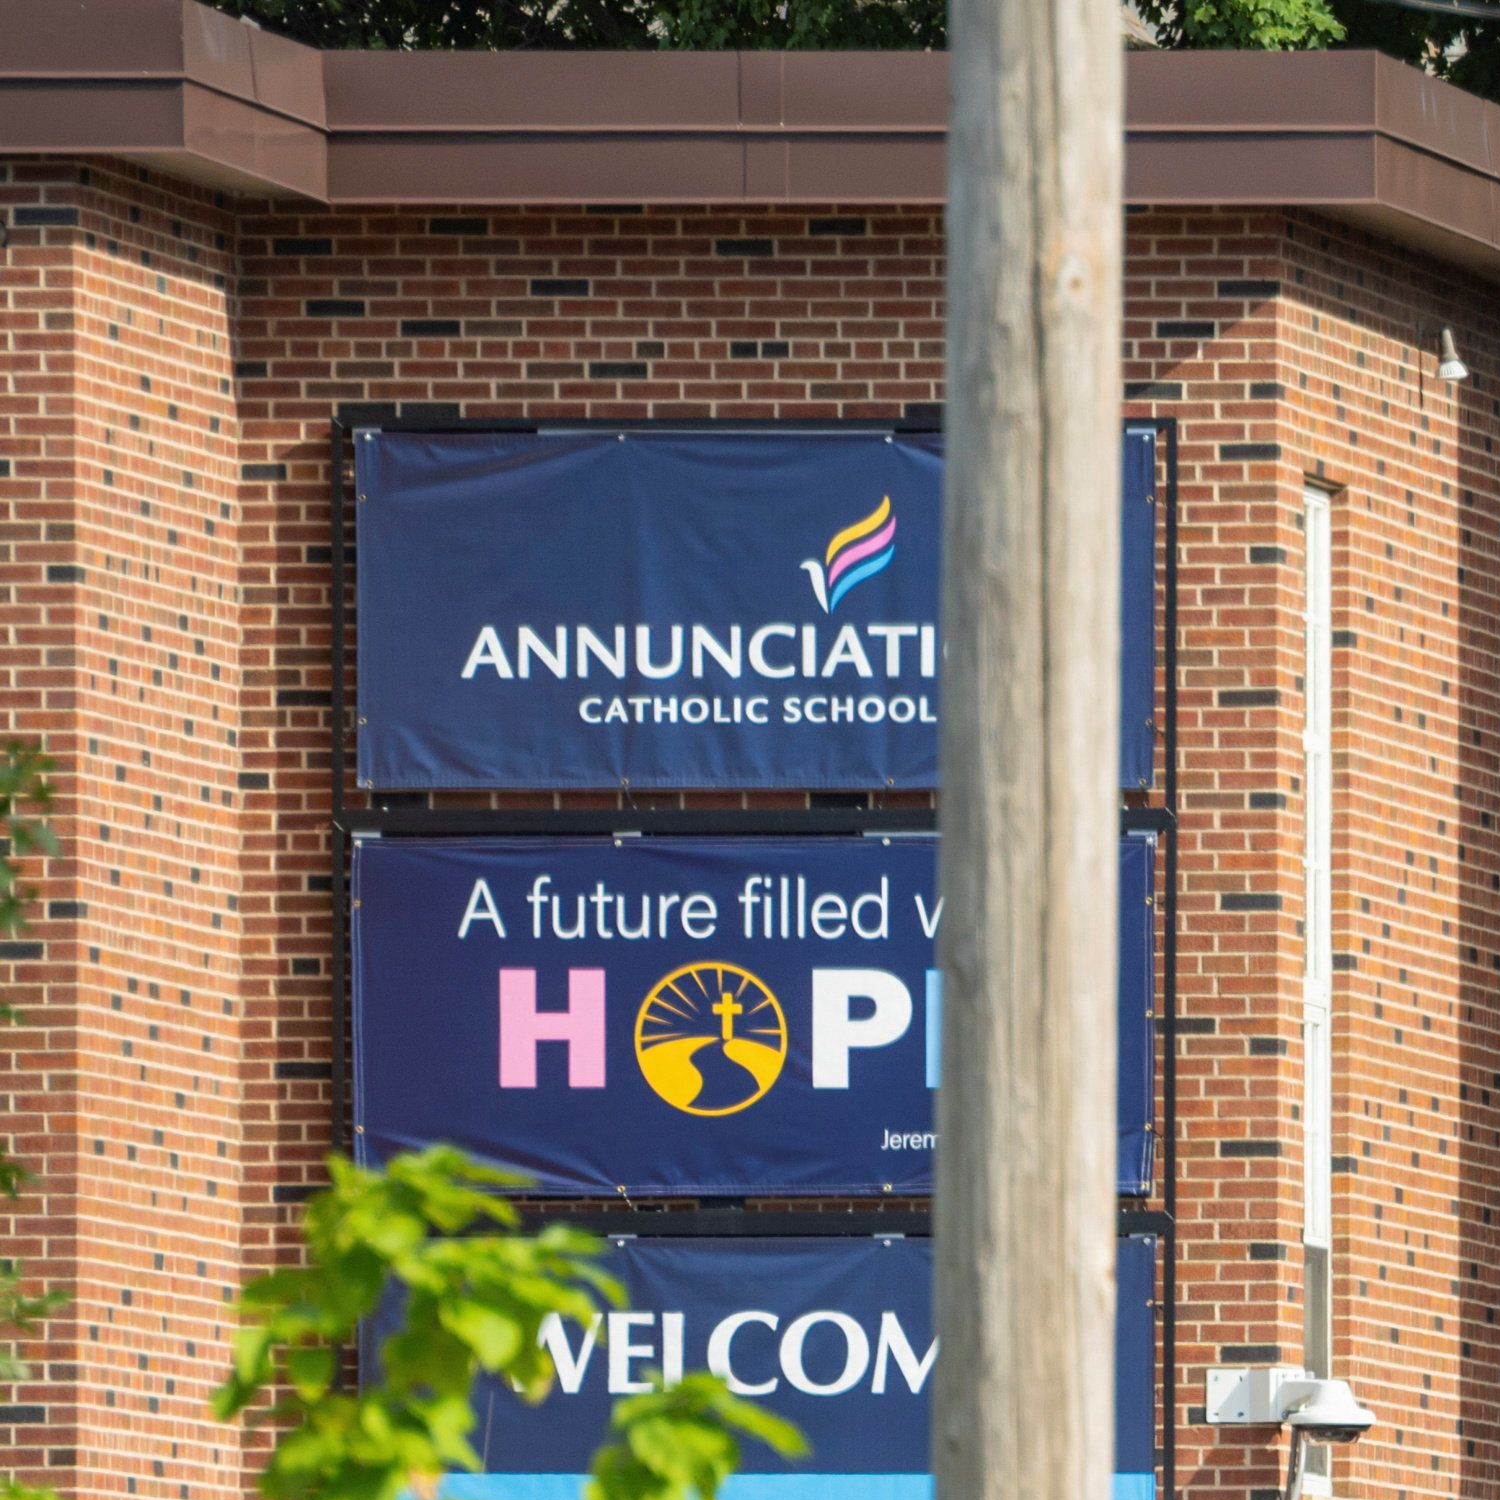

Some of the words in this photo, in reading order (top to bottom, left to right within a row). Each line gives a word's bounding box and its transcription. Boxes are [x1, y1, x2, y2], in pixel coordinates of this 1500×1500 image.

[460, 623, 946, 679] ANNUNCIATI
[579, 695, 769, 724] CATHOLIC
[783, 695, 938, 724] SCHOOL
[457, 878, 507, 939] A
[526, 875, 719, 940] future
[737, 875, 890, 940] filled
[499, 961, 939, 1117] HOP
